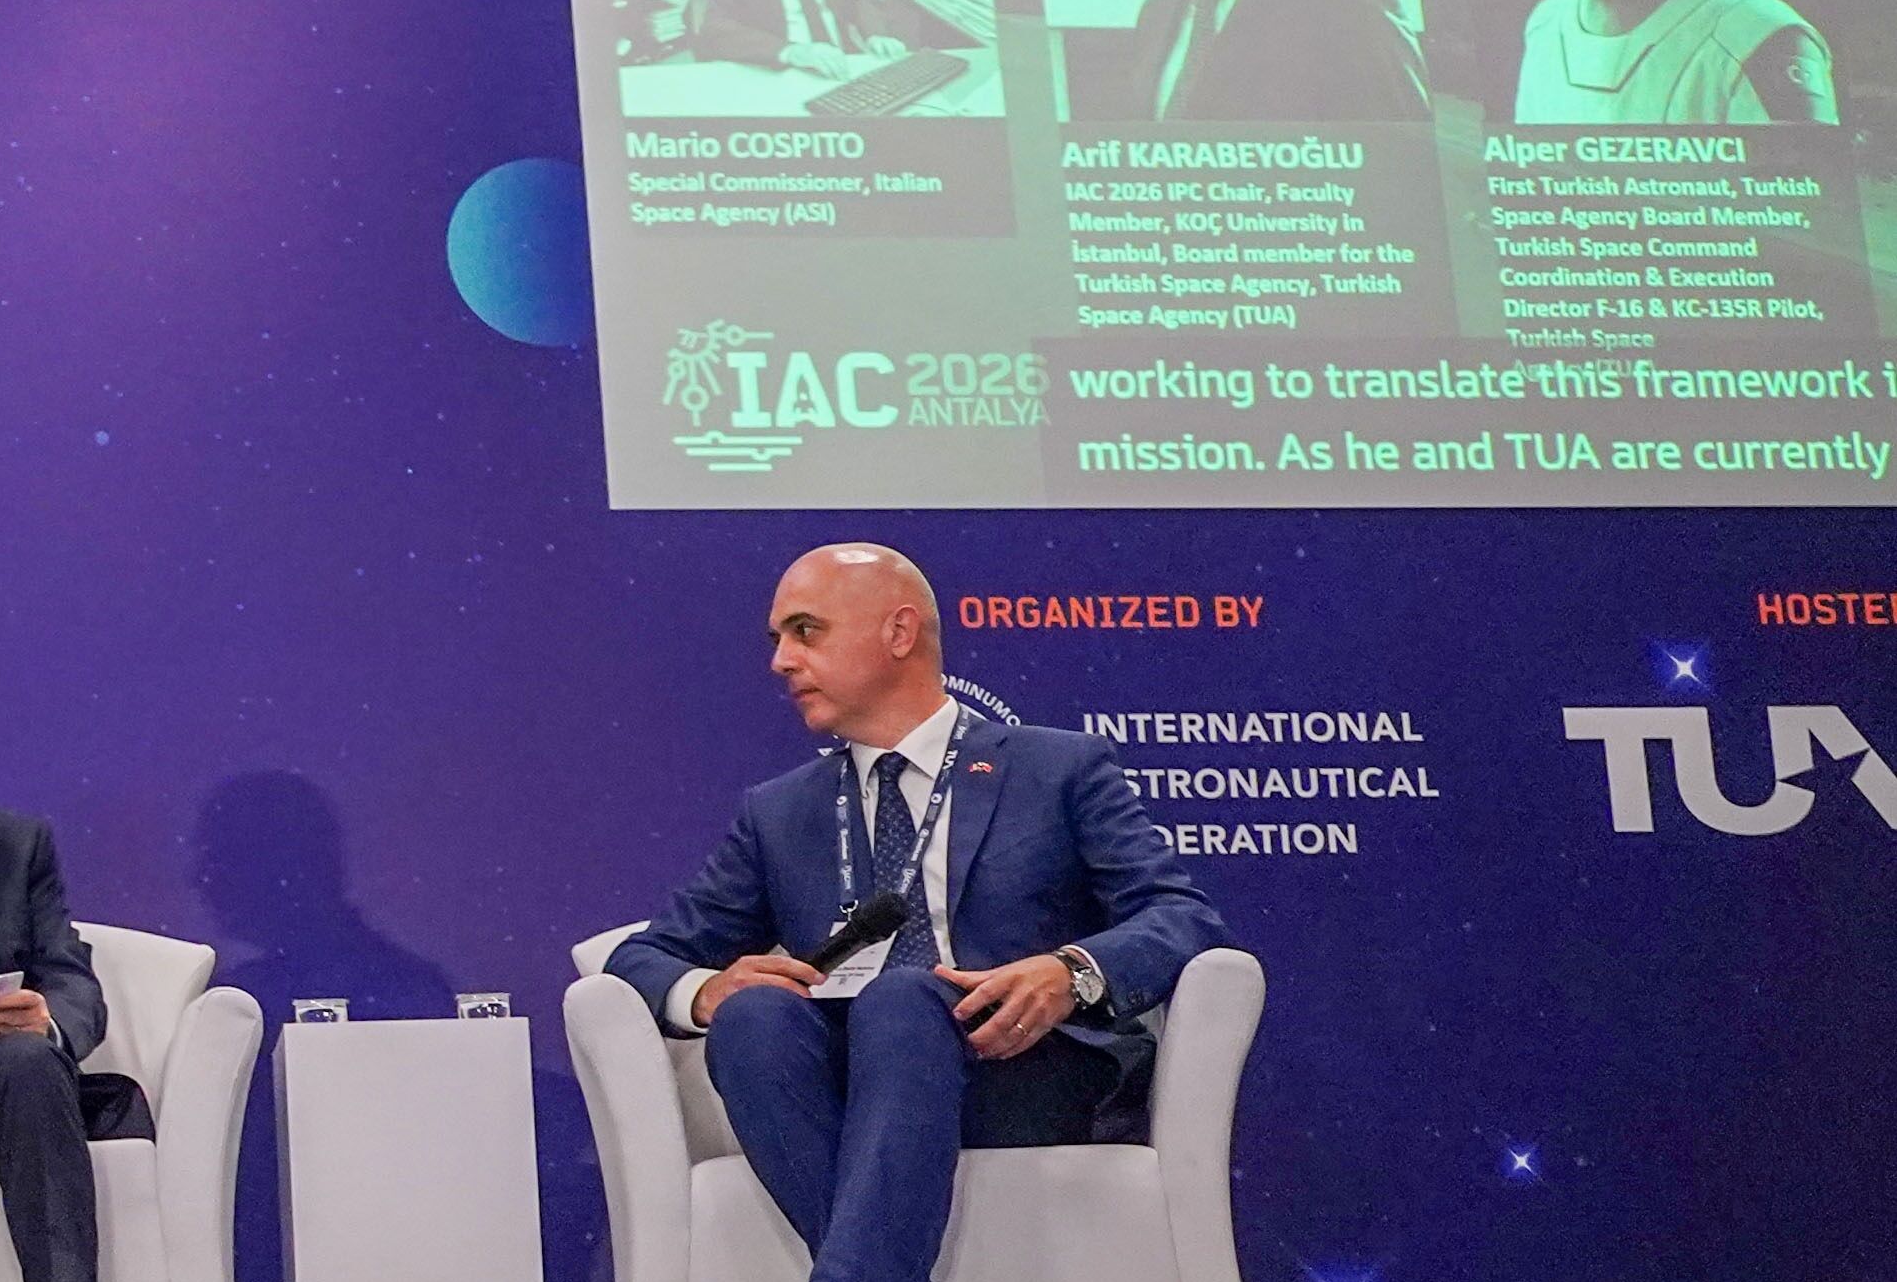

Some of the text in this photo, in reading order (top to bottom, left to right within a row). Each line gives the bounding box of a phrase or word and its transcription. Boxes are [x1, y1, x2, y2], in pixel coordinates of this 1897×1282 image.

[626, 131, 865, 159] Mario COSPITO
[1062, 136, 1364, 168] Arif KARABEYOĞLU
[1484, 135, 1747, 168] Alper GEZERAVCI
[628, 172, 942, 195] Special Commissioner, Italian
[1066, 182, 1355, 206] IAC 2026 IPC Chair, Faculty
[630, 201, 836, 226] Space Agency (ASI)
[1504, 298, 1824, 321] Director F-16 KC-135R Pilot,
[726, 351, 1050, 428] IAC 2026
[1070, 359, 1255, 409] working
[1265, 363, 1313, 399] to
[1324, 359, 1525, 400] translate
[1535, 359, 1623, 399] this
[1634, 359, 1874, 399] framework
[909, 396, 1051, 426] ANTALYA
[1077, 431, 1890, 480] mission. As he and TUA are currently
[960, 595, 1263, 629] ORGANIZED BY
[1083, 711, 1423, 744] INTERNATIONAL
[1123, 766, 1440, 800] STRONAUTICAL
